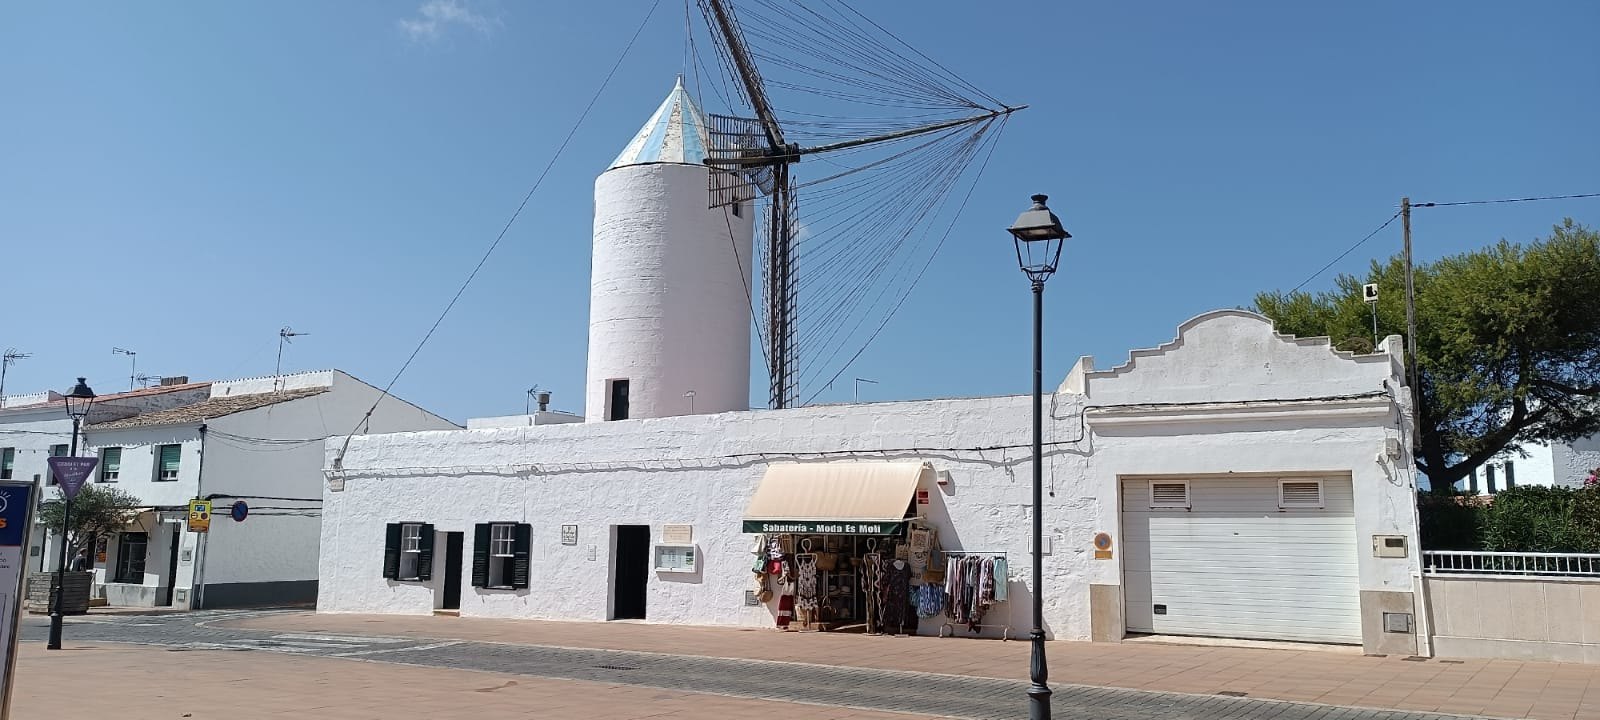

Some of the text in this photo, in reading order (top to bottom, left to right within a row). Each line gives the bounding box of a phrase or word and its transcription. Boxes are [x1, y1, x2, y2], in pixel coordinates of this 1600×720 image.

[762, 523, 807, 532] Sabatería
[816, 524, 843, 533] Moda
[845, 524, 856, 533] Es
